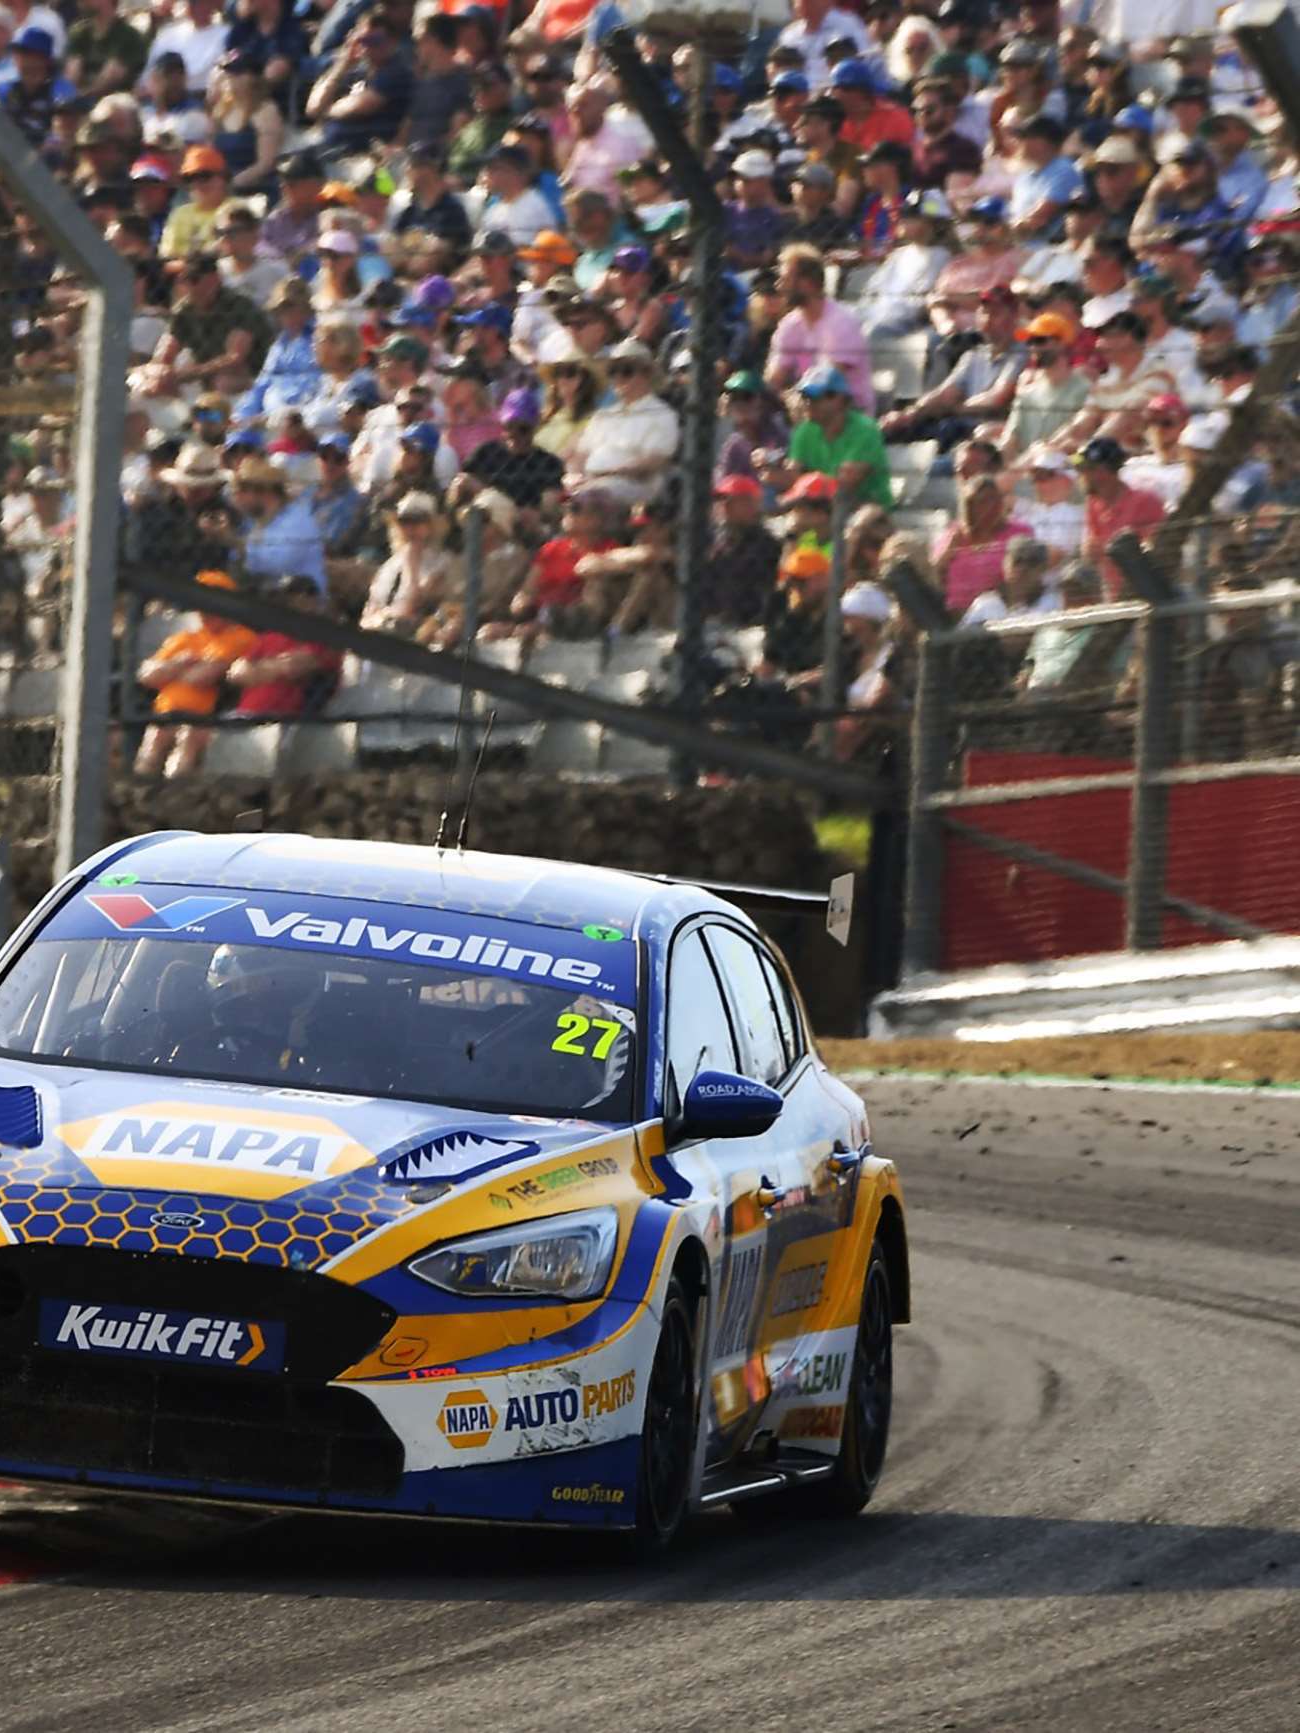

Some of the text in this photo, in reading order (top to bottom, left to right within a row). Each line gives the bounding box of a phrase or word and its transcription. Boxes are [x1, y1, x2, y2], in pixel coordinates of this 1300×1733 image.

[245, 907, 602, 985] Valvoline
[551, 1013, 622, 1060] 27
[697, 1084, 735, 1097] ROAD
[103, 1118, 321, 1172] NAPA
[506, 1179, 545, 1200] THE
[446, 1369, 636, 1434] NAPA AUTO PARTS
